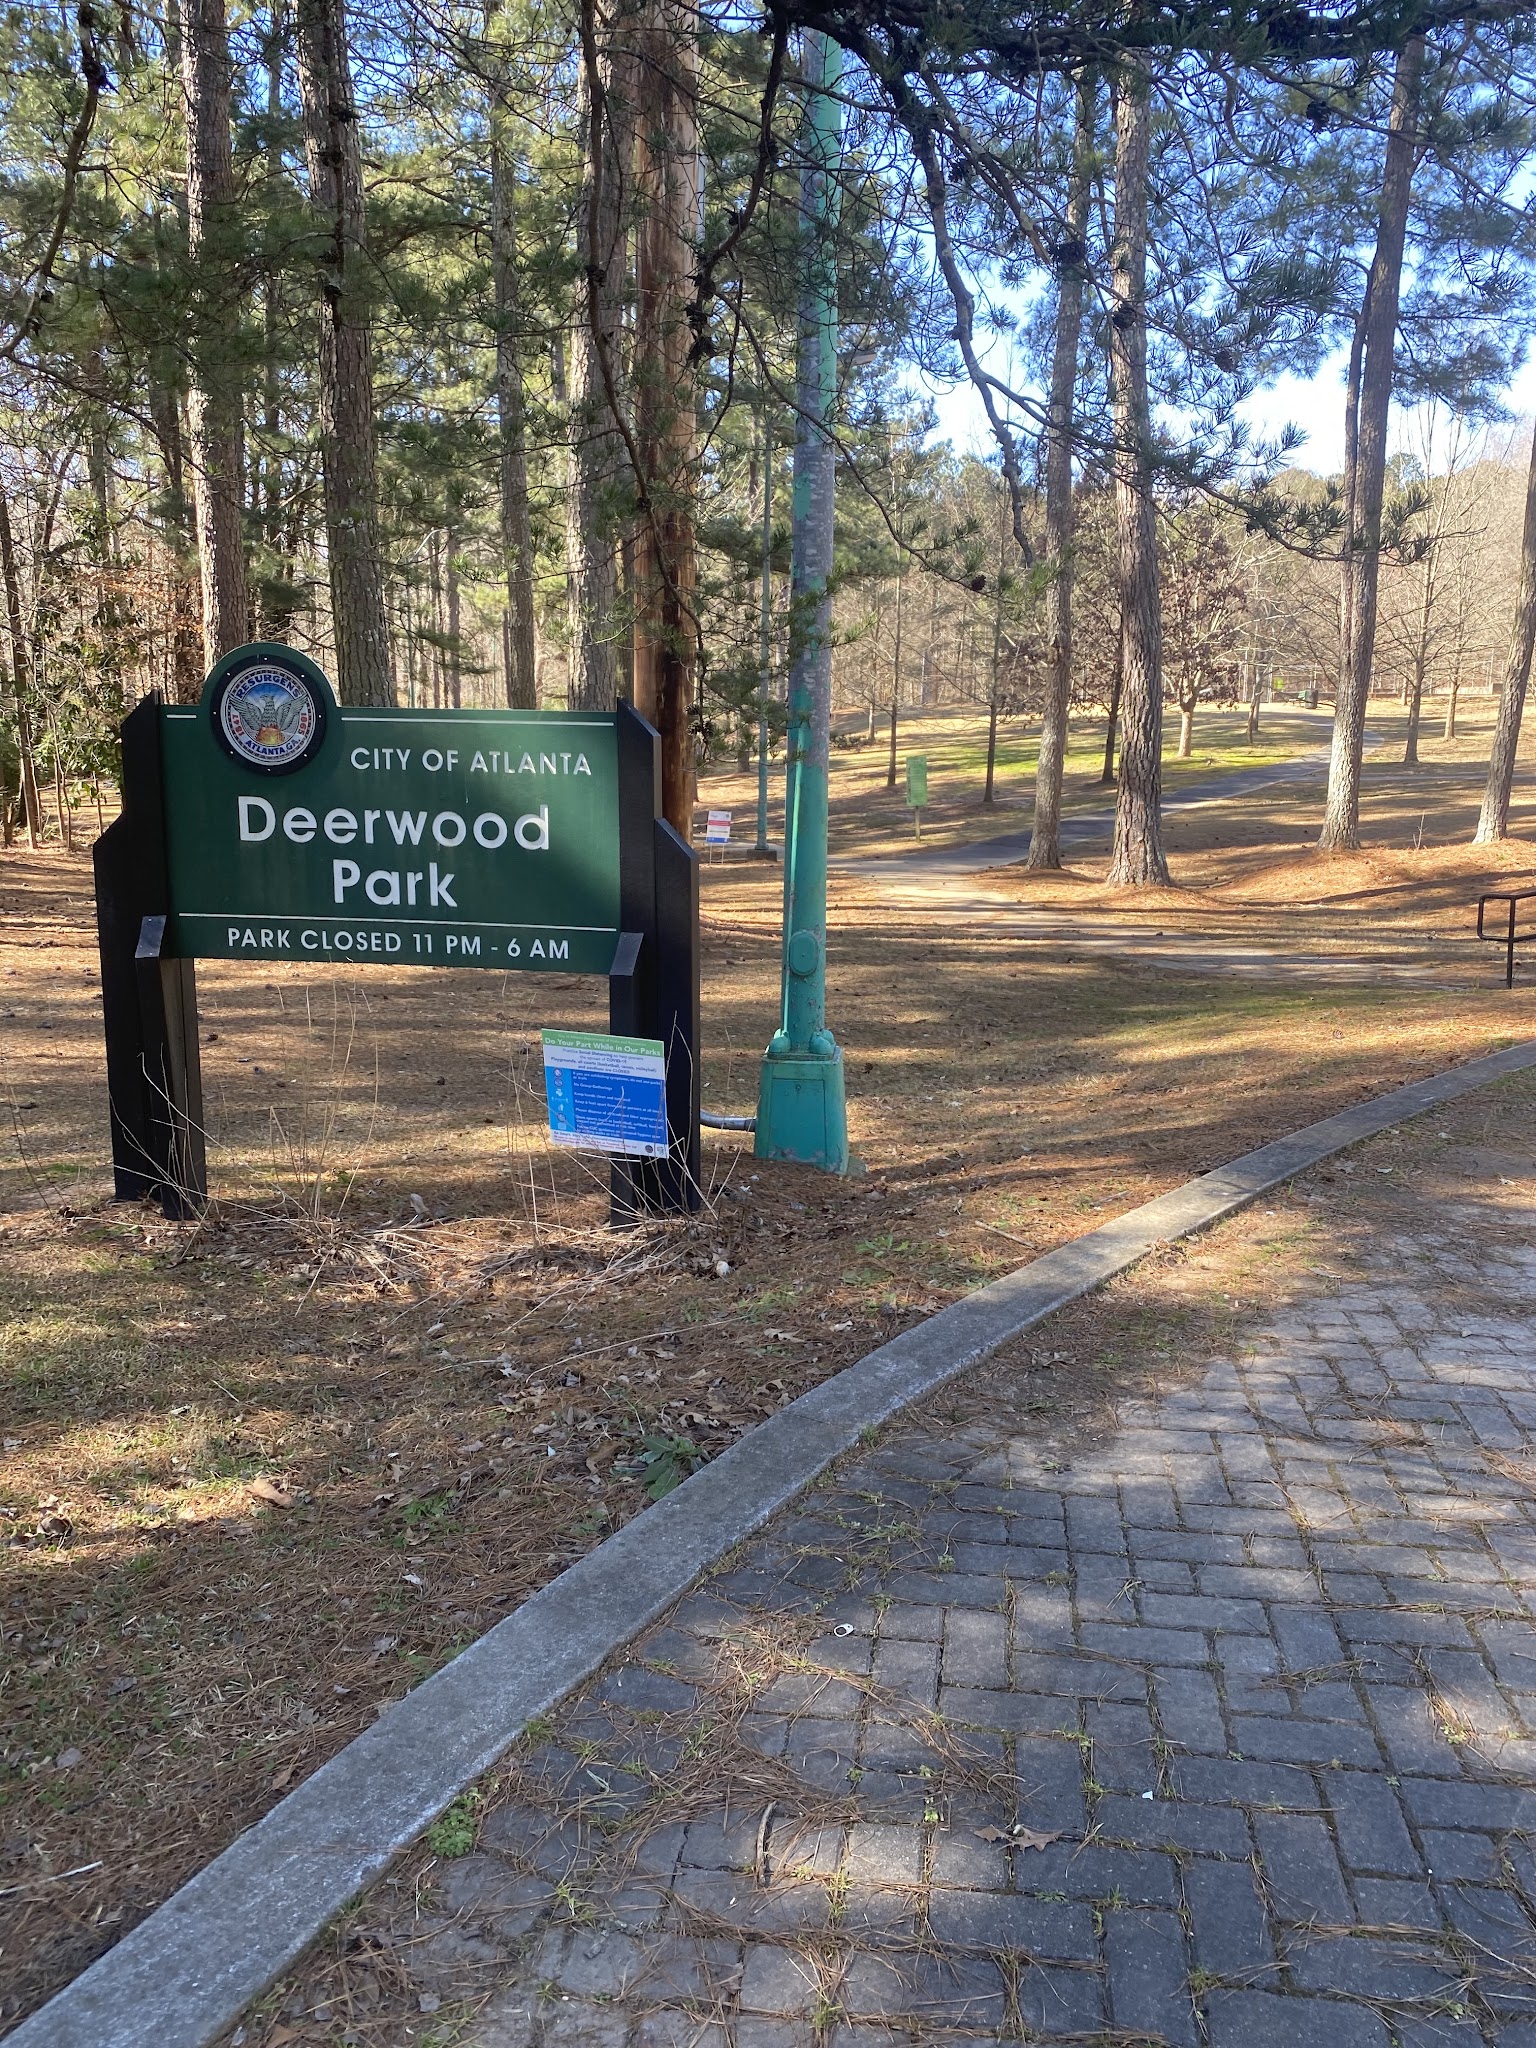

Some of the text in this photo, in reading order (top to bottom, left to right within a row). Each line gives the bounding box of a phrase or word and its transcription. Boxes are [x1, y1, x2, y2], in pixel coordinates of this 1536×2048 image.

[235, 674, 300, 698] RESURGENS
[231, 714, 244, 737] 1847
[298, 712, 307, 736] 1865
[350, 747, 592, 777] CITY OF ATLANTA
[238, 796, 550, 850] Deerwood
[333, 859, 458, 907] Park
[228, 927, 291, 949] PARK
[300, 929, 402, 952] CLOSED
[412, 933, 432, 953] 11
[446, 935, 481, 956] PM
[507, 938, 521, 957] 6
[529, 938, 569, 960] AM
[545, 1037, 556, 1045] Do
[557, 1039, 574, 1047] Your
[576, 1040, 592, 1048] Part
[593, 1042, 613, 1051] While
[624, 1046, 639, 1054] Our
[640, 1047, 661, 1056] Parks
